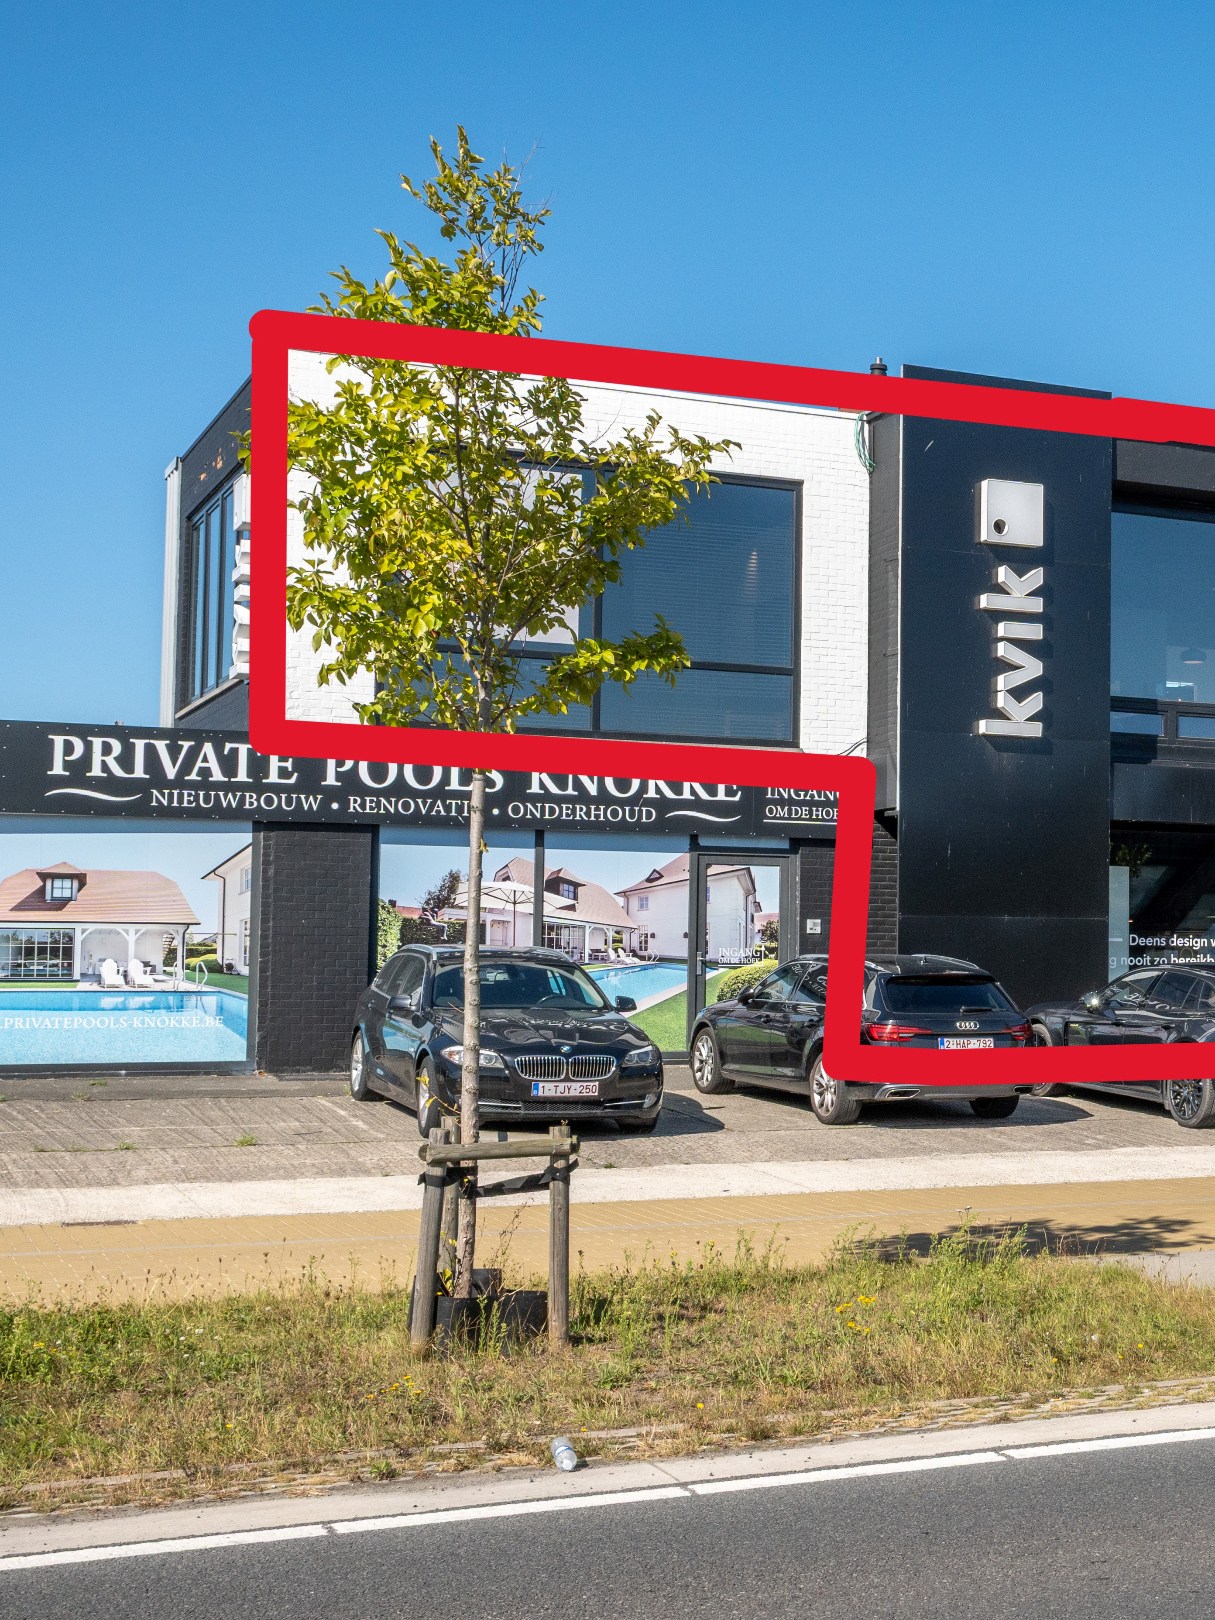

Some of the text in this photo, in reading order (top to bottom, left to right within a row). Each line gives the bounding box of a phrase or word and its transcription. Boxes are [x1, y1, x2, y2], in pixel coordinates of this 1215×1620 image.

[47, 735, 298, 784] PRIVATE
[150, 789, 657, 823] NIEUWBOUW RENOVATI ONDERHOUD
[765, 805, 788, 818] OM
[790, 807, 810, 819] DE
[1129, 934, 1166, 946] Deens
[1169, 934, 1208, 949] design
[719, 948, 760, 957] INGANG
[1120, 954, 1151, 966] nooit
[541, 1084, 598, 1095] 1-TJY-250
